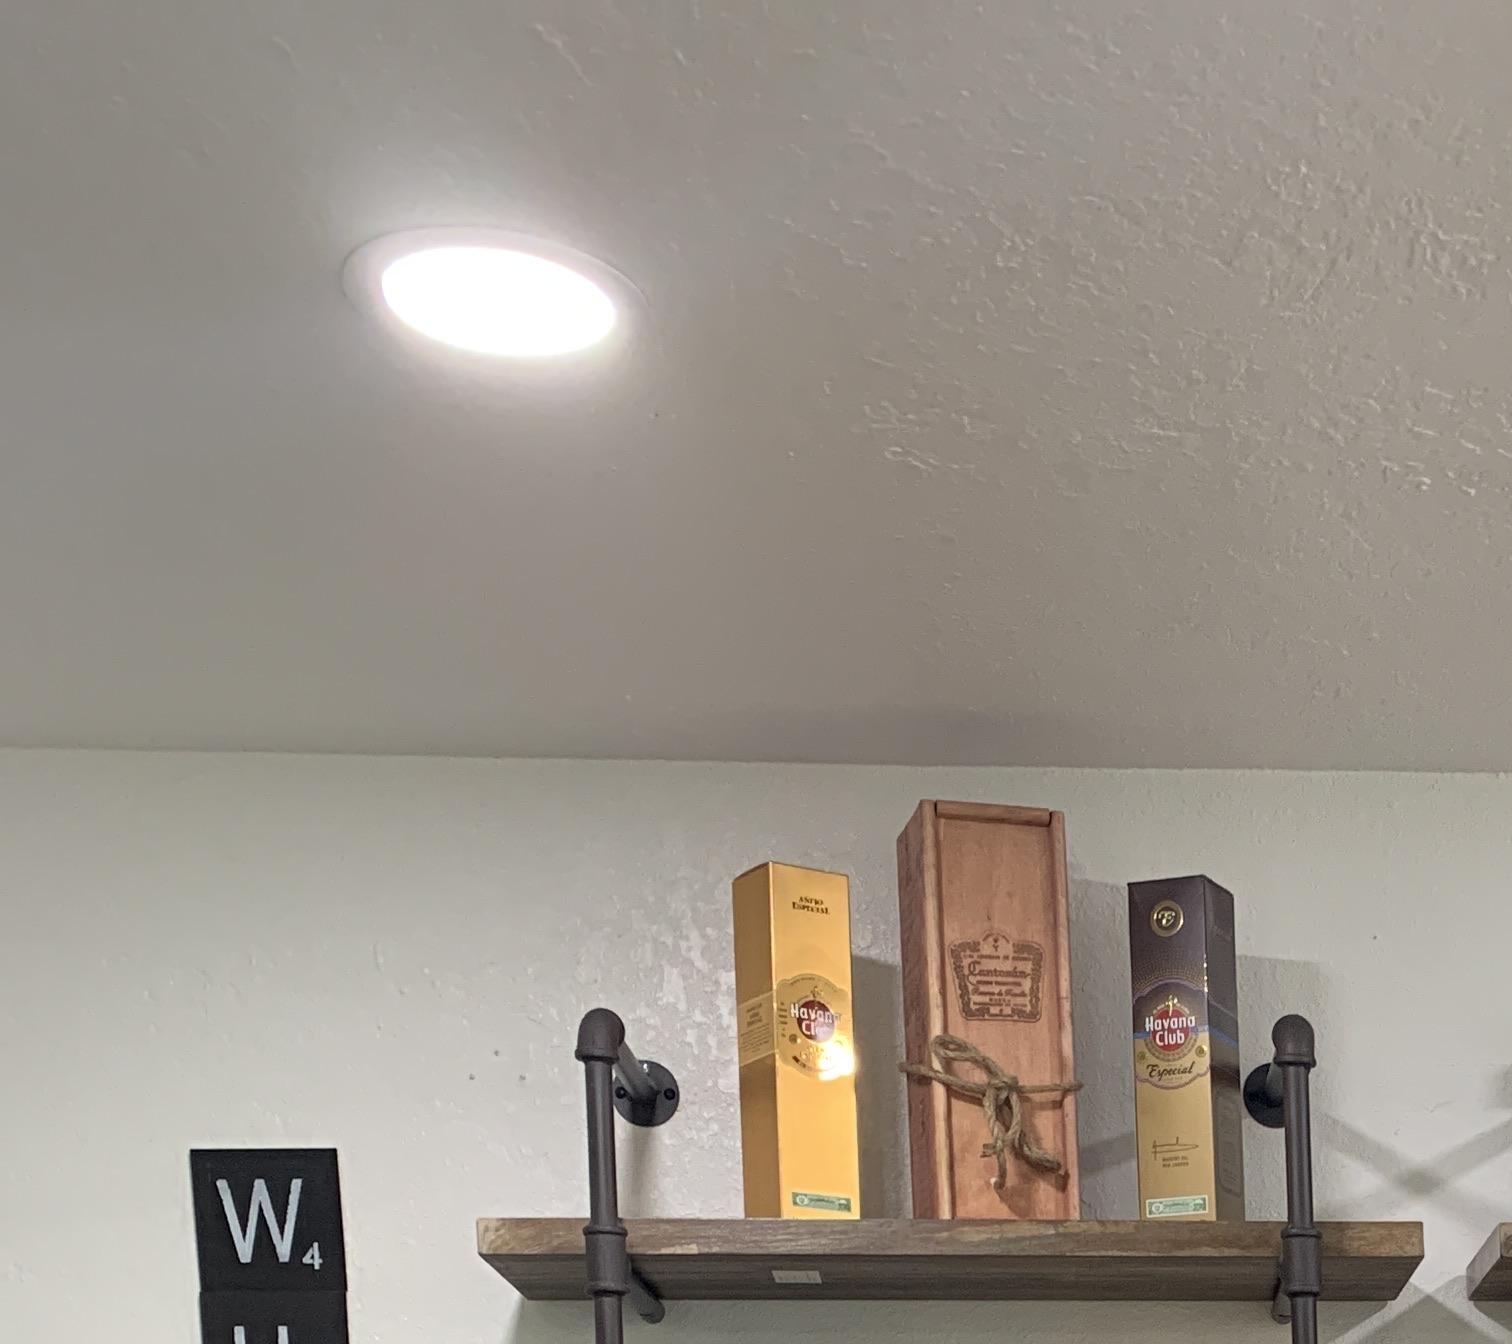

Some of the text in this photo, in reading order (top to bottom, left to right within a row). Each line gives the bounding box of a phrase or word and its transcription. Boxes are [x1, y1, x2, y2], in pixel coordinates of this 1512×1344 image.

[1145, 1015, 1195, 1032] Havana
[1155, 1030, 1185, 1047] Club
[1146, 1060, 1196, 1082] Especial
